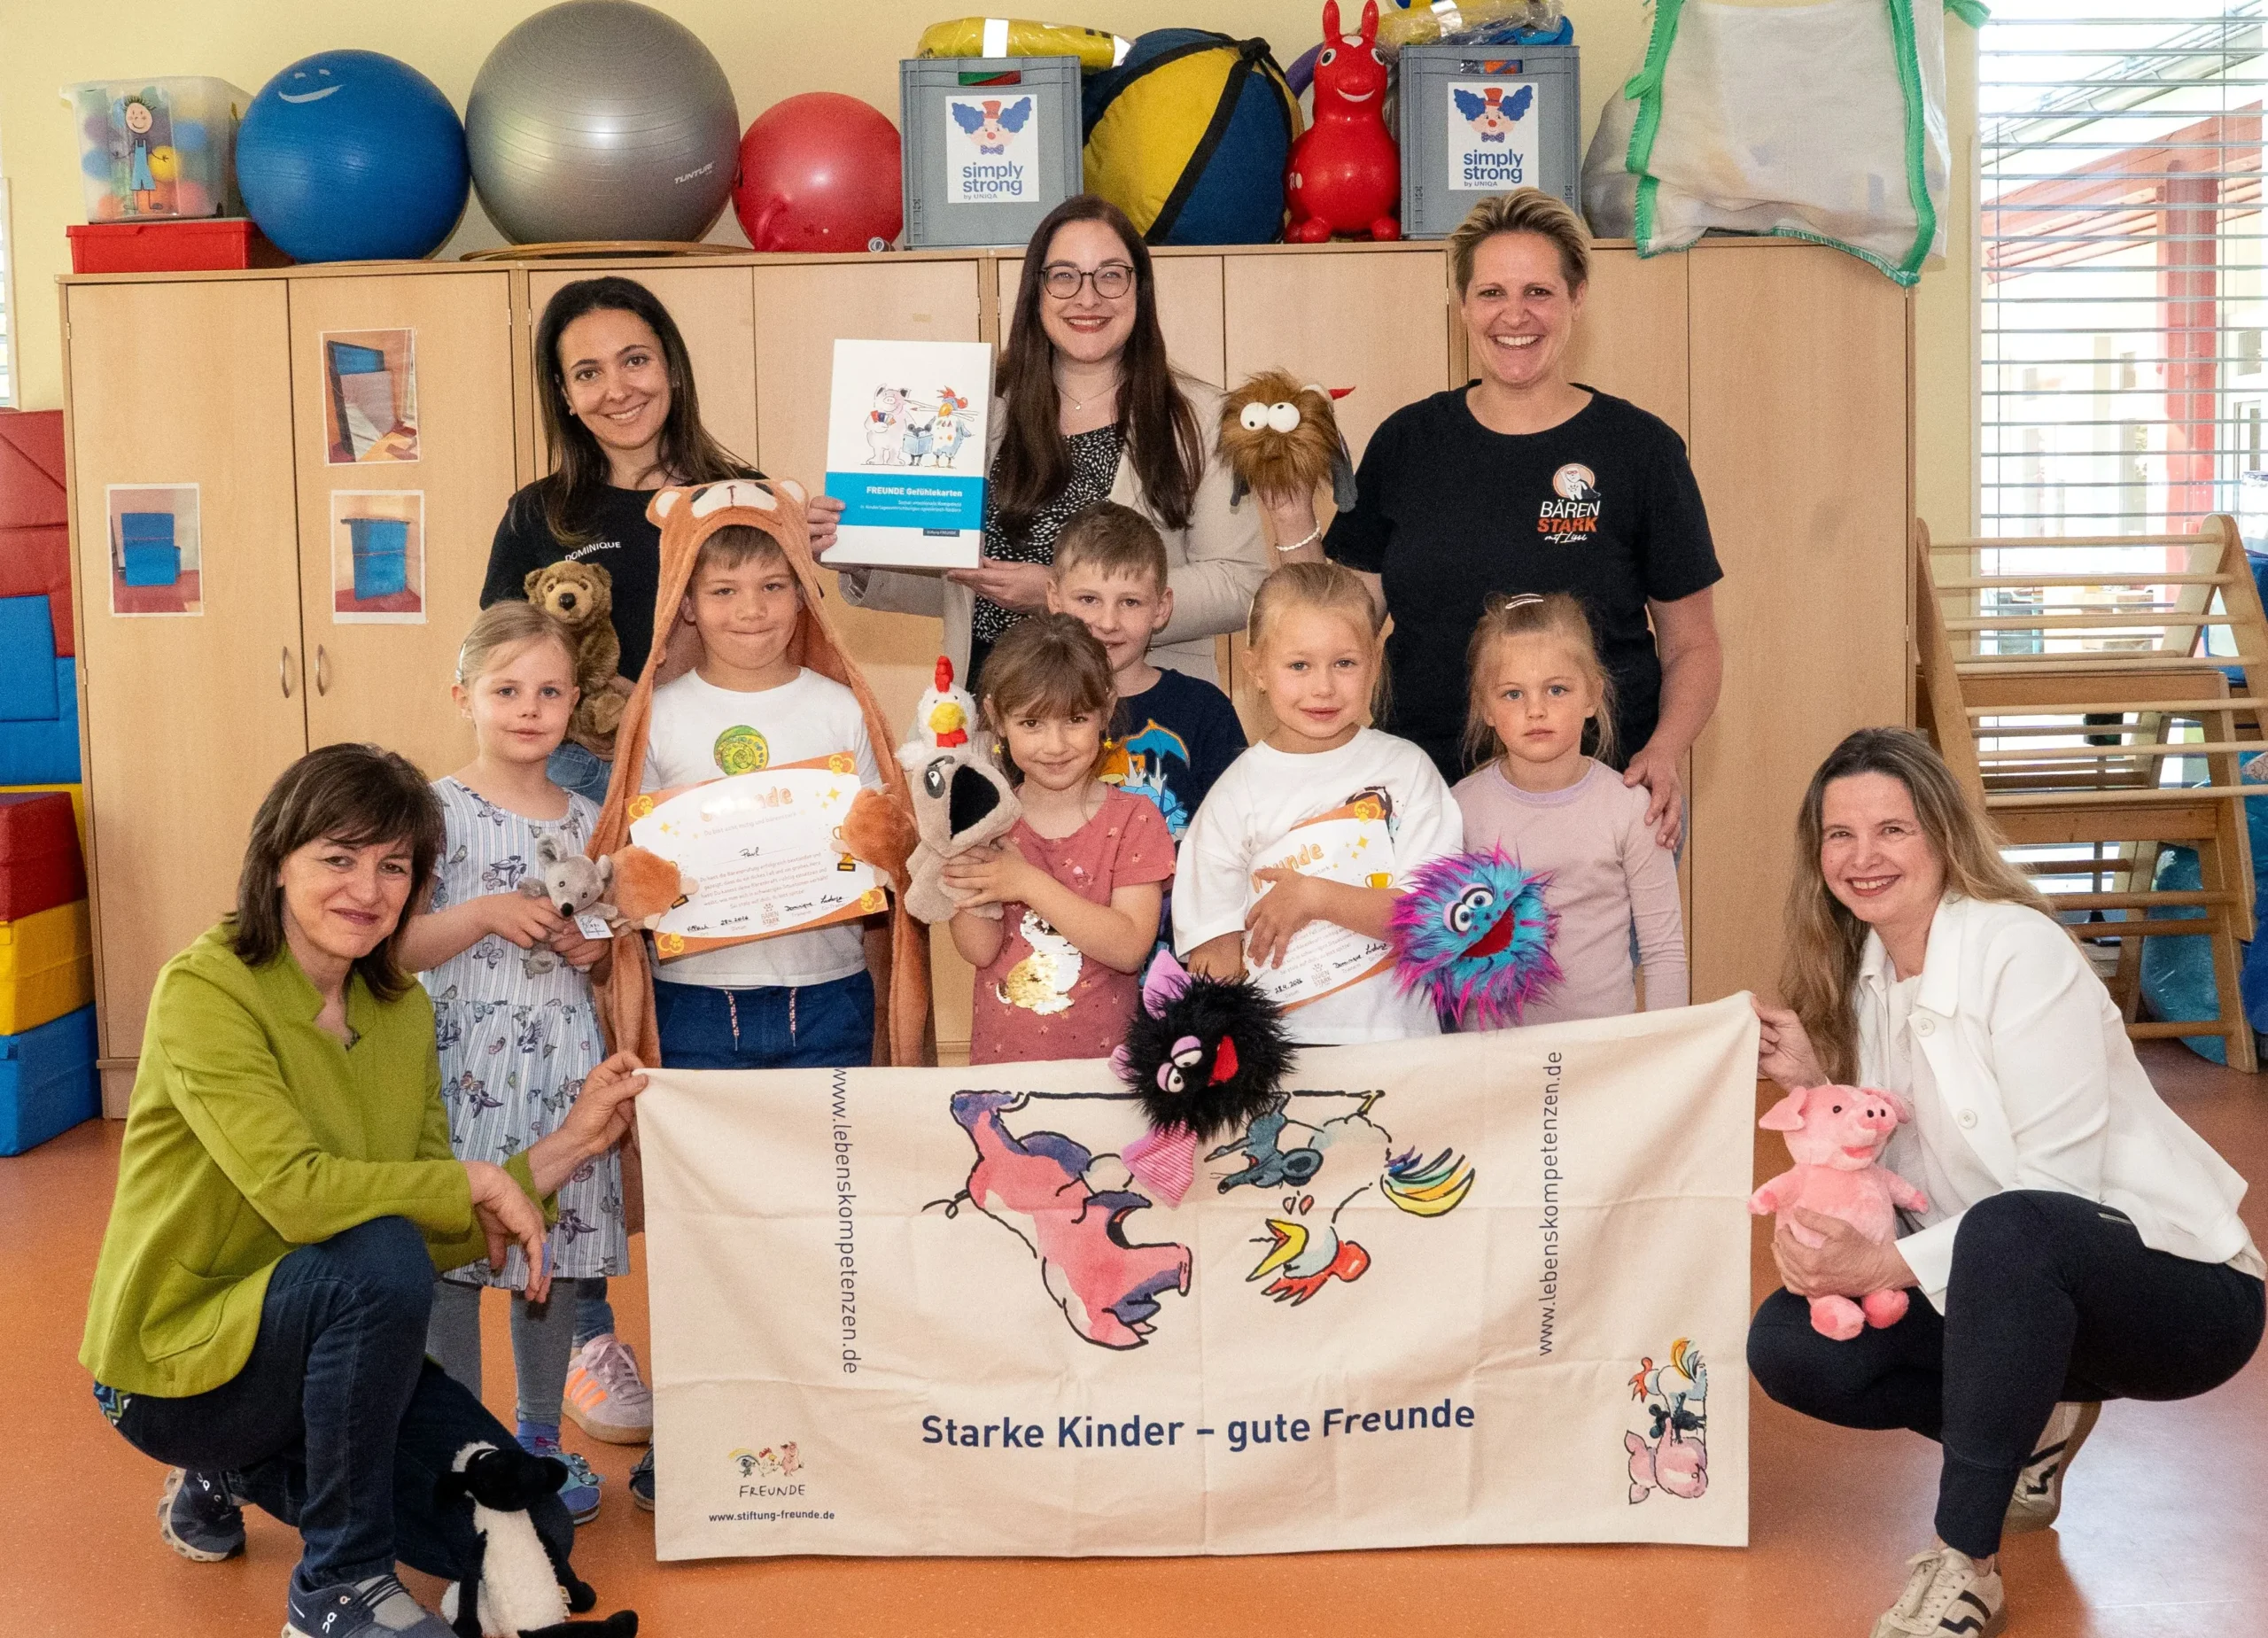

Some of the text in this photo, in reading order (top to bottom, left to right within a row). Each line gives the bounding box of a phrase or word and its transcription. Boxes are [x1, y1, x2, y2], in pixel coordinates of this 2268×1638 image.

[1463, 149, 1524, 167] simply
[962, 160, 1024, 180] simply
[1463, 166, 1523, 184] strong
[962, 178, 1023, 196] strong
[906, 488, 962, 497] Gefühlekarten
[1540, 499, 1601, 518] BÄREN
[1537, 516, 1598, 532] STARK
[564, 541, 622, 562] DOMINIQUE
[740, 848, 760, 858] Paul
[1538, 1052, 1564, 1356] www.lebenskompetenzen.de
[832, 1067, 862, 1373] www.lebenskompetenzen.de
[921, 1415, 1045, 1448] Starke
[1058, 1414, 1185, 1448] Kinder
[1227, 1414, 1311, 1453] gute
[1324, 1398, 1476, 1438] Freunde
[739, 1484, 806, 1498] FREUNDE
[708, 1510, 835, 1522] www.stiftung-freunde.de
